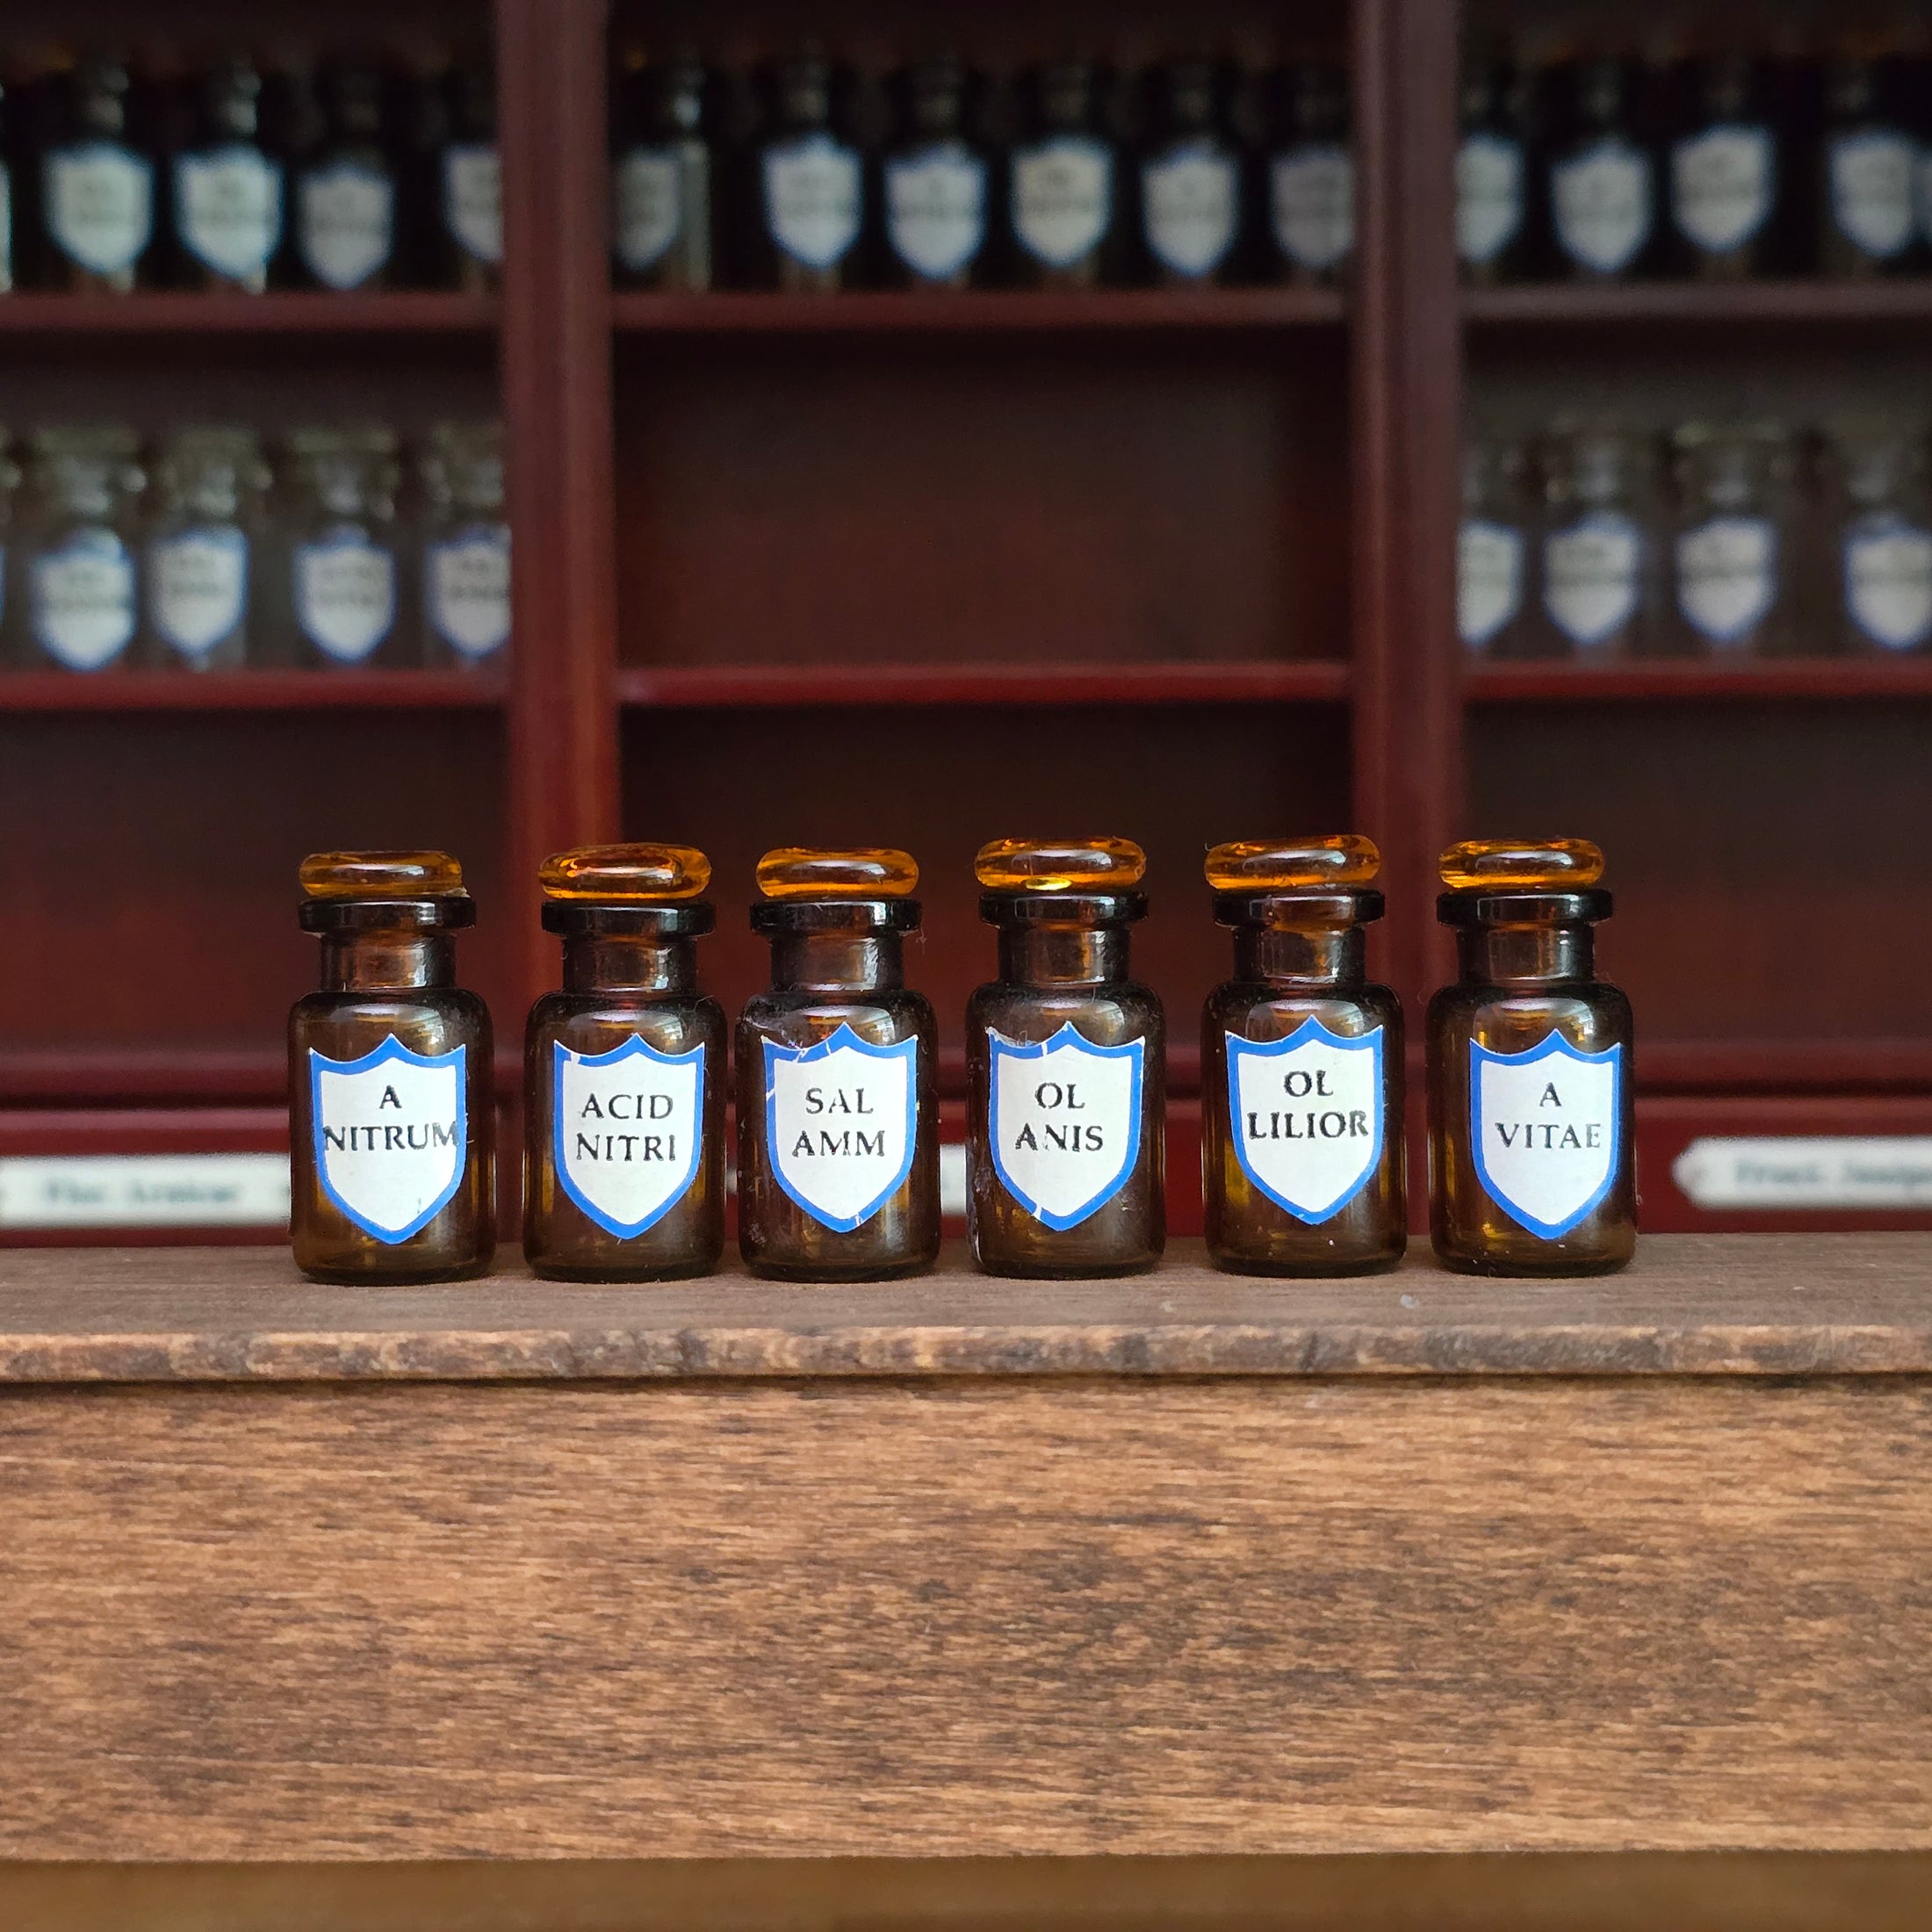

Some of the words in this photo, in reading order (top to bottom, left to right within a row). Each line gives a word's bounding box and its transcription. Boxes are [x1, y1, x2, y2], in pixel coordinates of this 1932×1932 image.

[379, 1085, 402, 1109] A
[1034, 1082, 1086, 1110] OL
[1283, 1070, 1334, 1097] OL
[1539, 1082, 1562, 1107] A
[581, 1093, 674, 1120] ACID
[805, 1087, 874, 1114] SAL
[323, 1121, 460, 1150] NITRUM
[1015, 1123, 1104, 1151] ANIS
[1247, 1110, 1369, 1140] LILIOR
[1496, 1123, 1602, 1150] VITAE
[576, 1134, 675, 1162] NITRI
[792, 1129, 886, 1157] AMM
